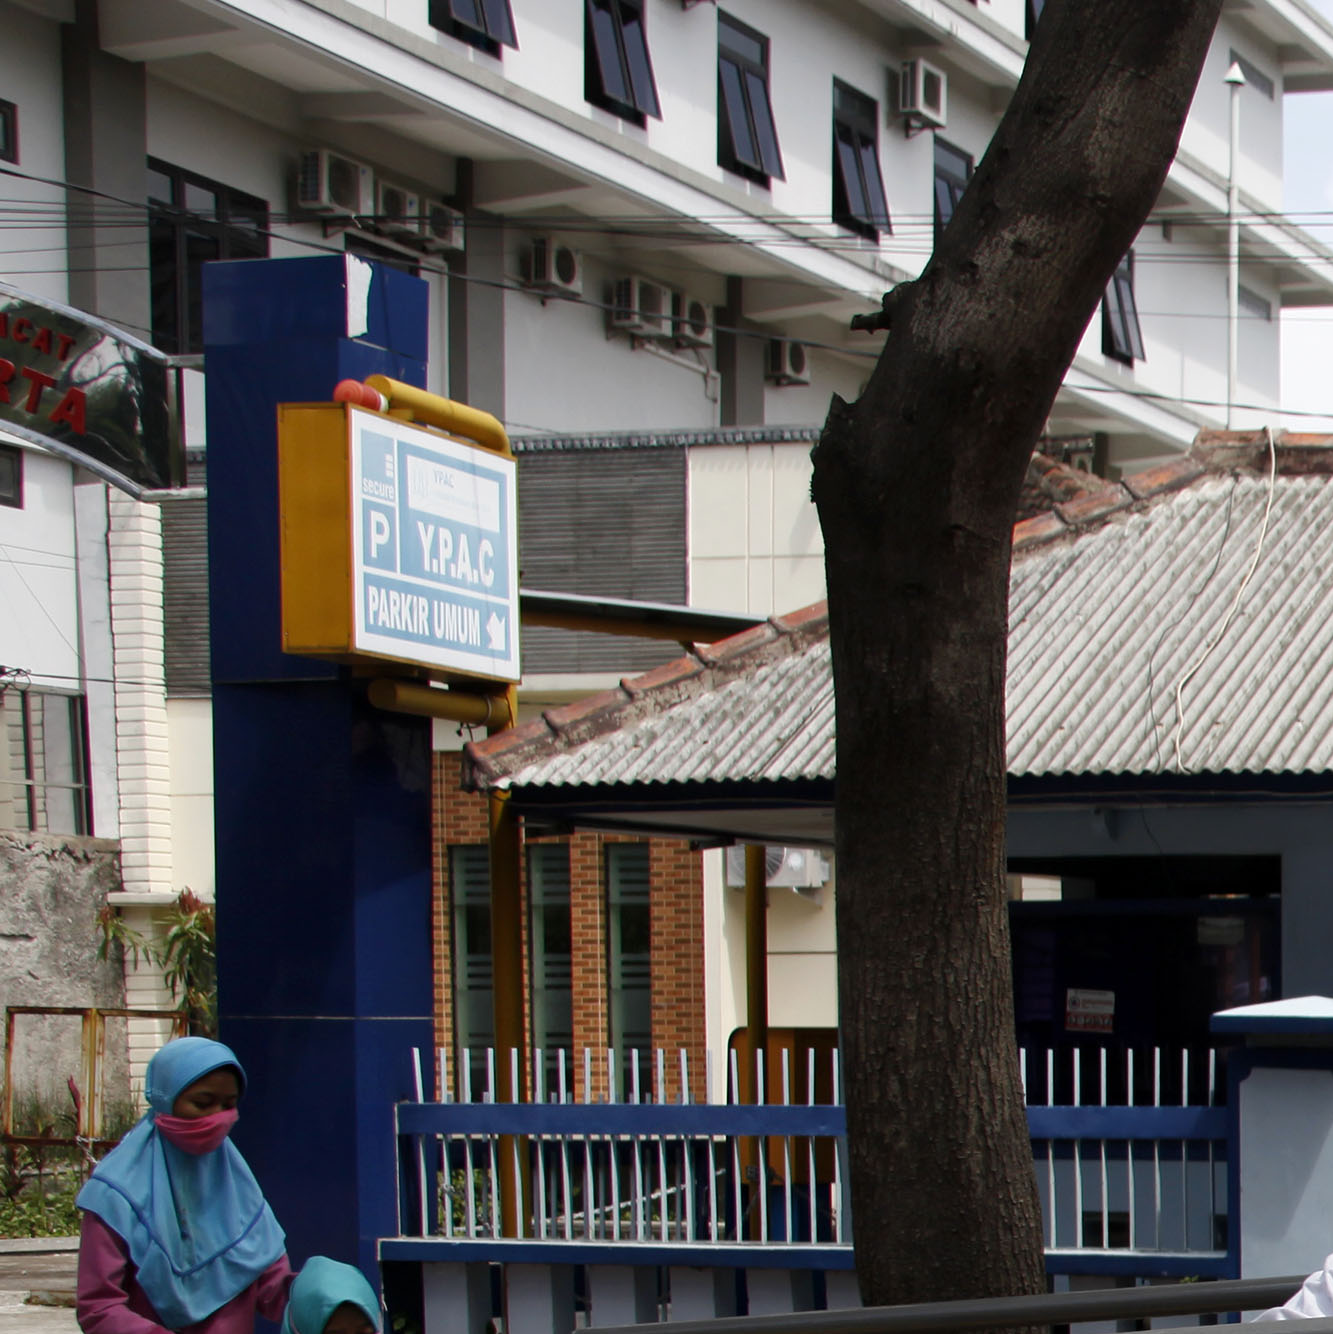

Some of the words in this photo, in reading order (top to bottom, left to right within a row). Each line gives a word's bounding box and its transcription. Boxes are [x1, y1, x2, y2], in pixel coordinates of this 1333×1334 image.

[363, 478, 394, 500] secure
[370, 511, 390, 558] P
[417, 520, 494, 587] Y.P.A.C
[368, 585, 429, 636] PARKIR
[433, 600, 481, 647] UMUM
